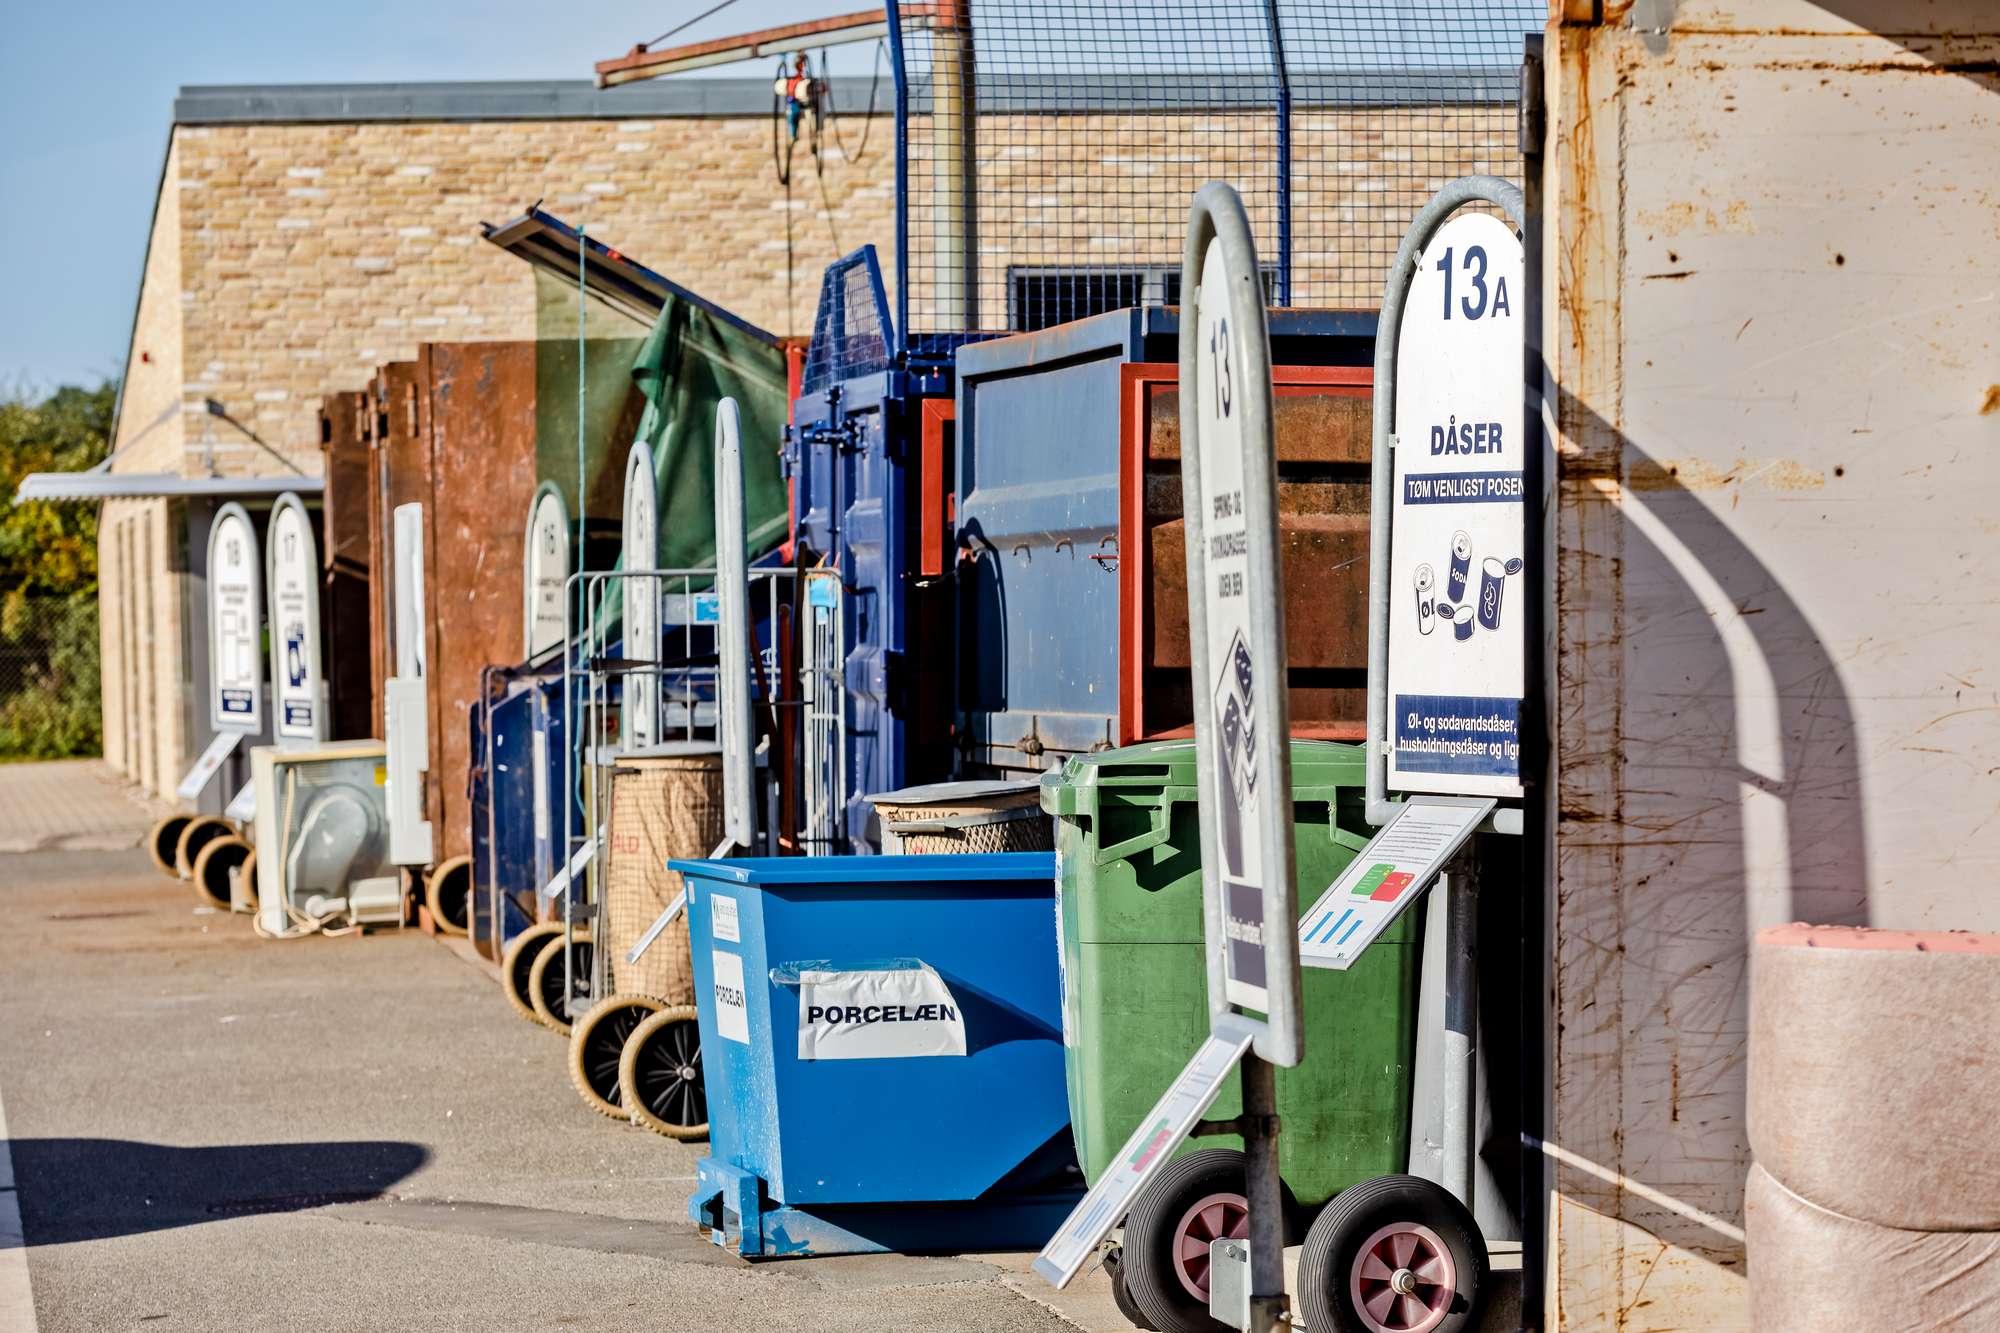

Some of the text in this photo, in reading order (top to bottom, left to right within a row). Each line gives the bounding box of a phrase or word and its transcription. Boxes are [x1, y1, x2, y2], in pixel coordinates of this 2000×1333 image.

[1210, 316, 1231, 420] 13
[1430, 414, 1504, 456] DÅSER
[1408, 480, 1431, 498] TØM
[1433, 478, 1485, 497] VENLIGST
[1423, 716, 1436, 733] og
[1437, 714, 1517, 735] sodavandsdåser,
[1400, 736, 1488, 758] husholdningsdåser
[1489, 743, 1502, 760] og
[715, 984, 745, 1009] PORCELÆN
[807, 1003, 957, 1025] PORCELÆN
